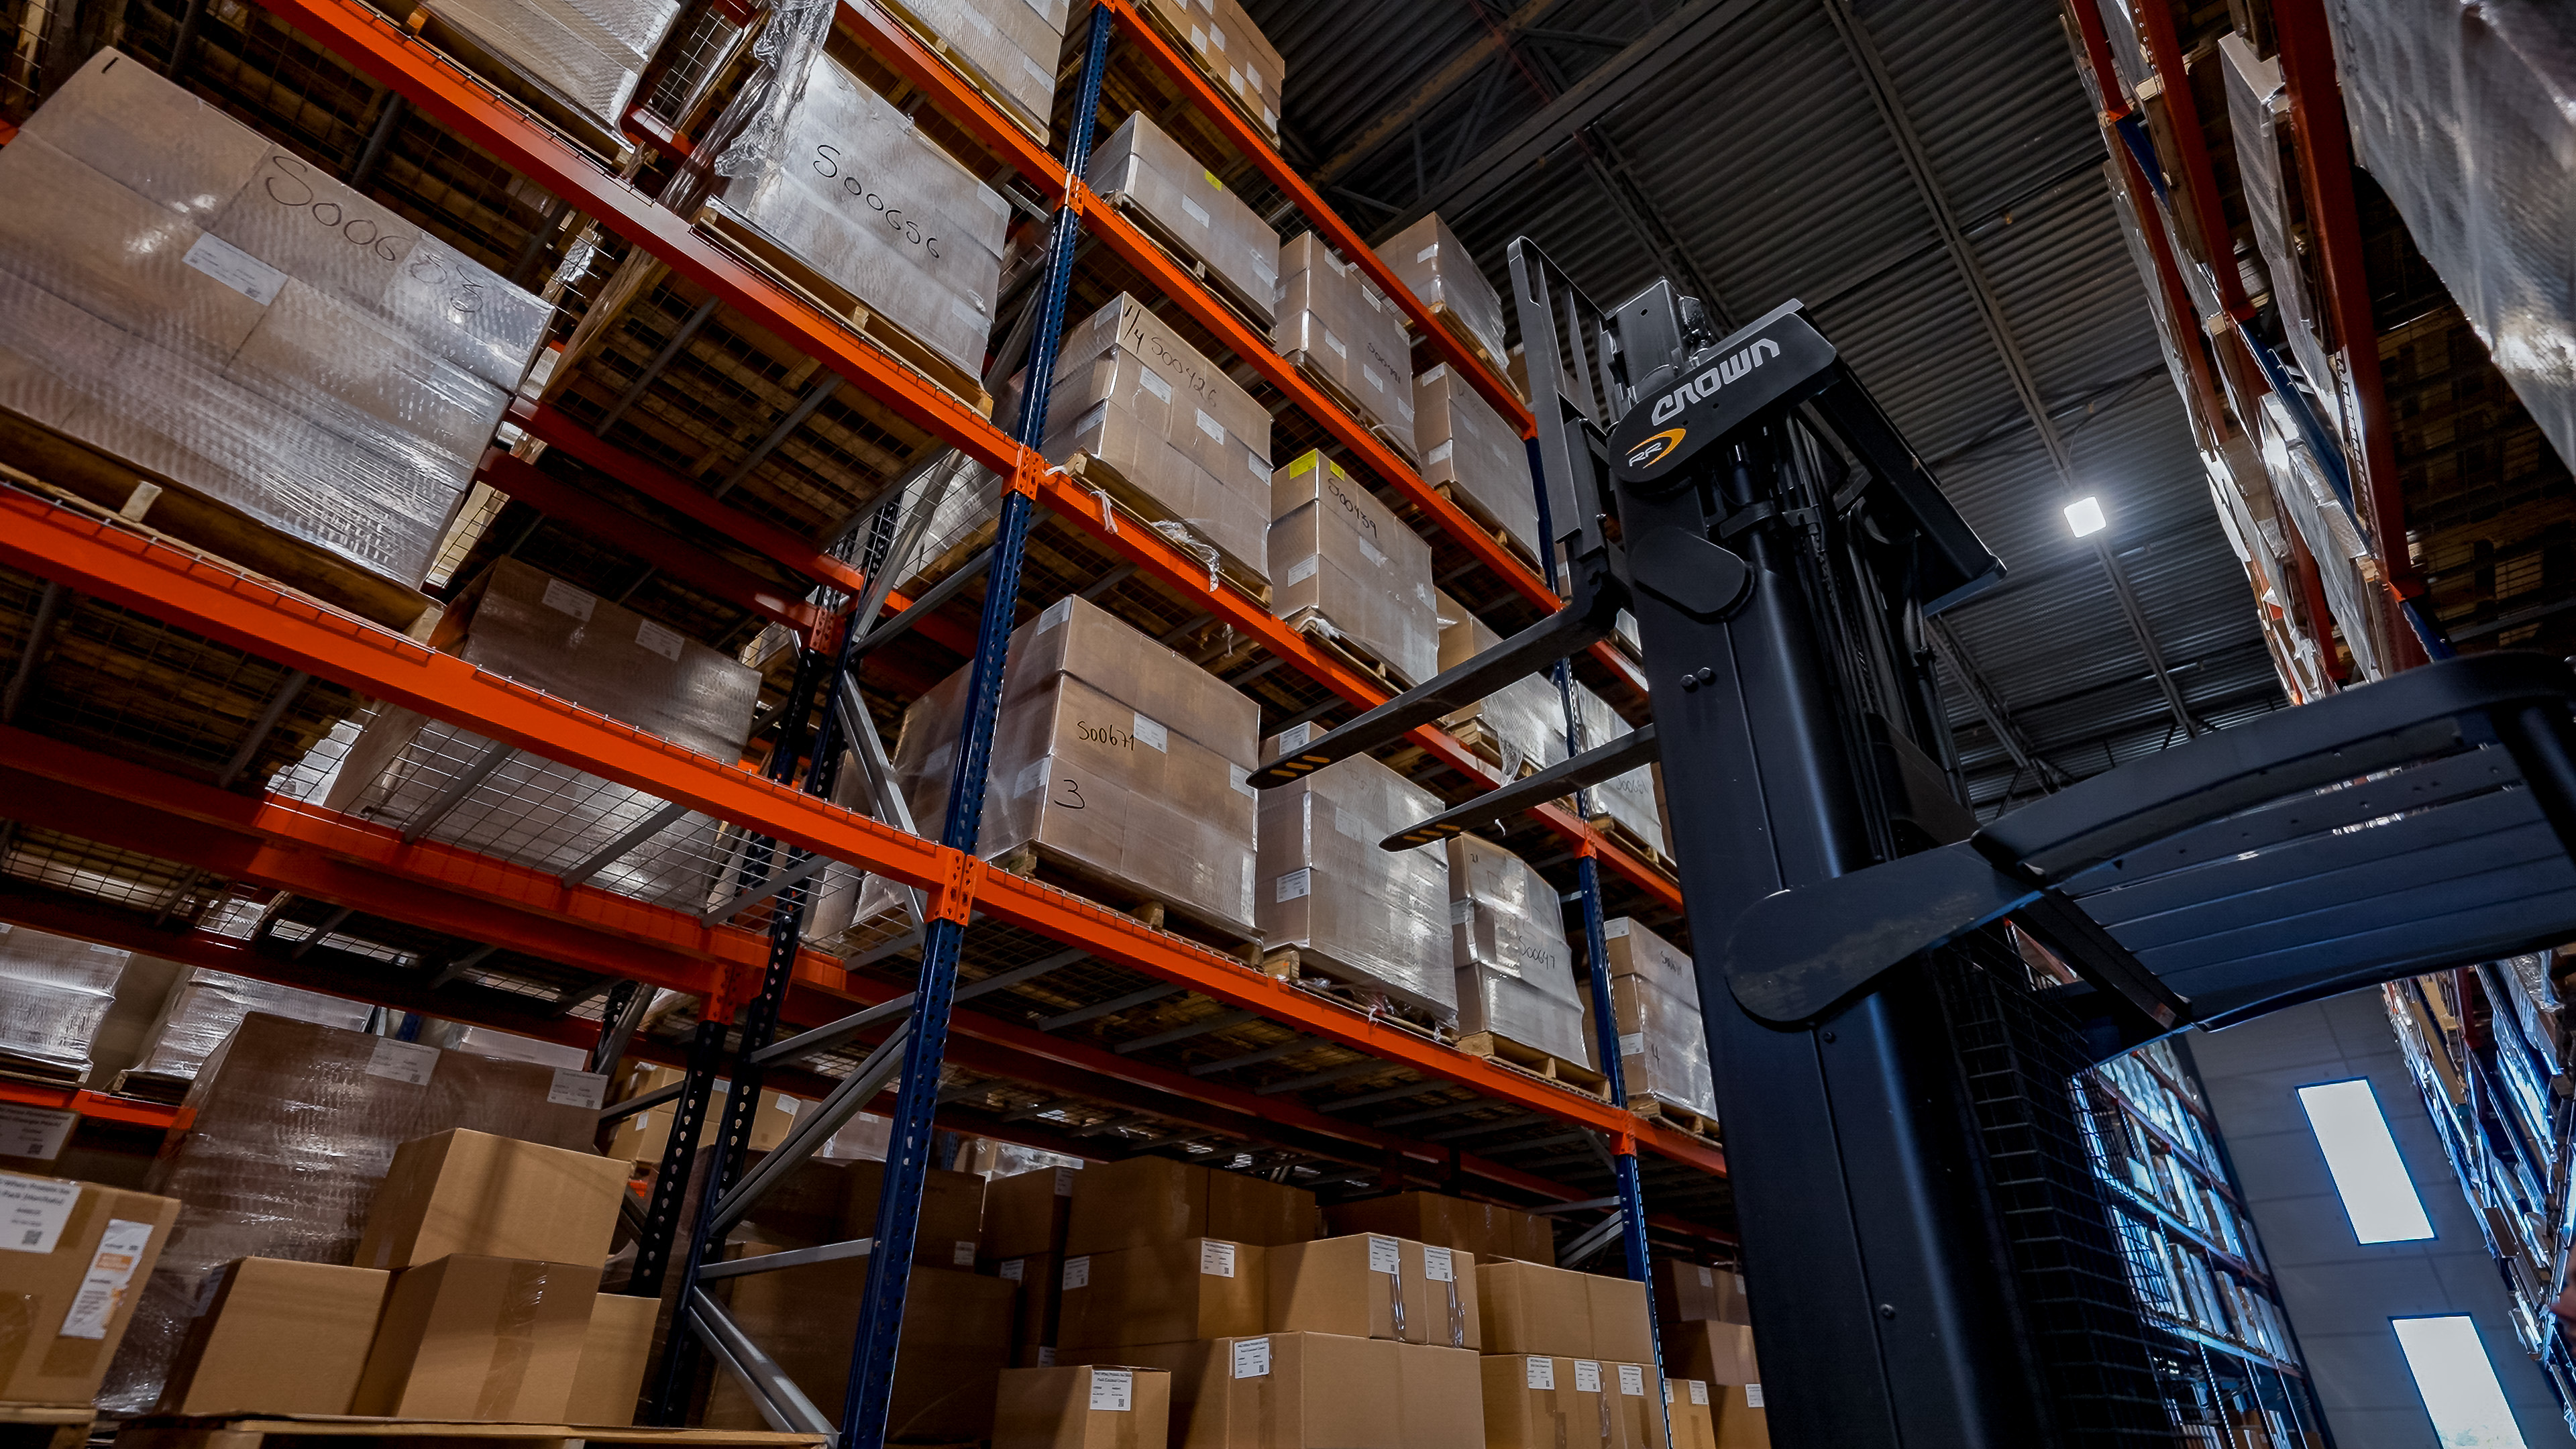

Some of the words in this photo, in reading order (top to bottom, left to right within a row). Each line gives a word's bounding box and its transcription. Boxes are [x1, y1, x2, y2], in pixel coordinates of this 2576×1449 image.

[1652, 338, 1780, 427] CROWN
[1628, 442, 1662, 467] RR
[1053, 778, 1086, 810] 3
[1651, 1043, 1660, 1071] 4
